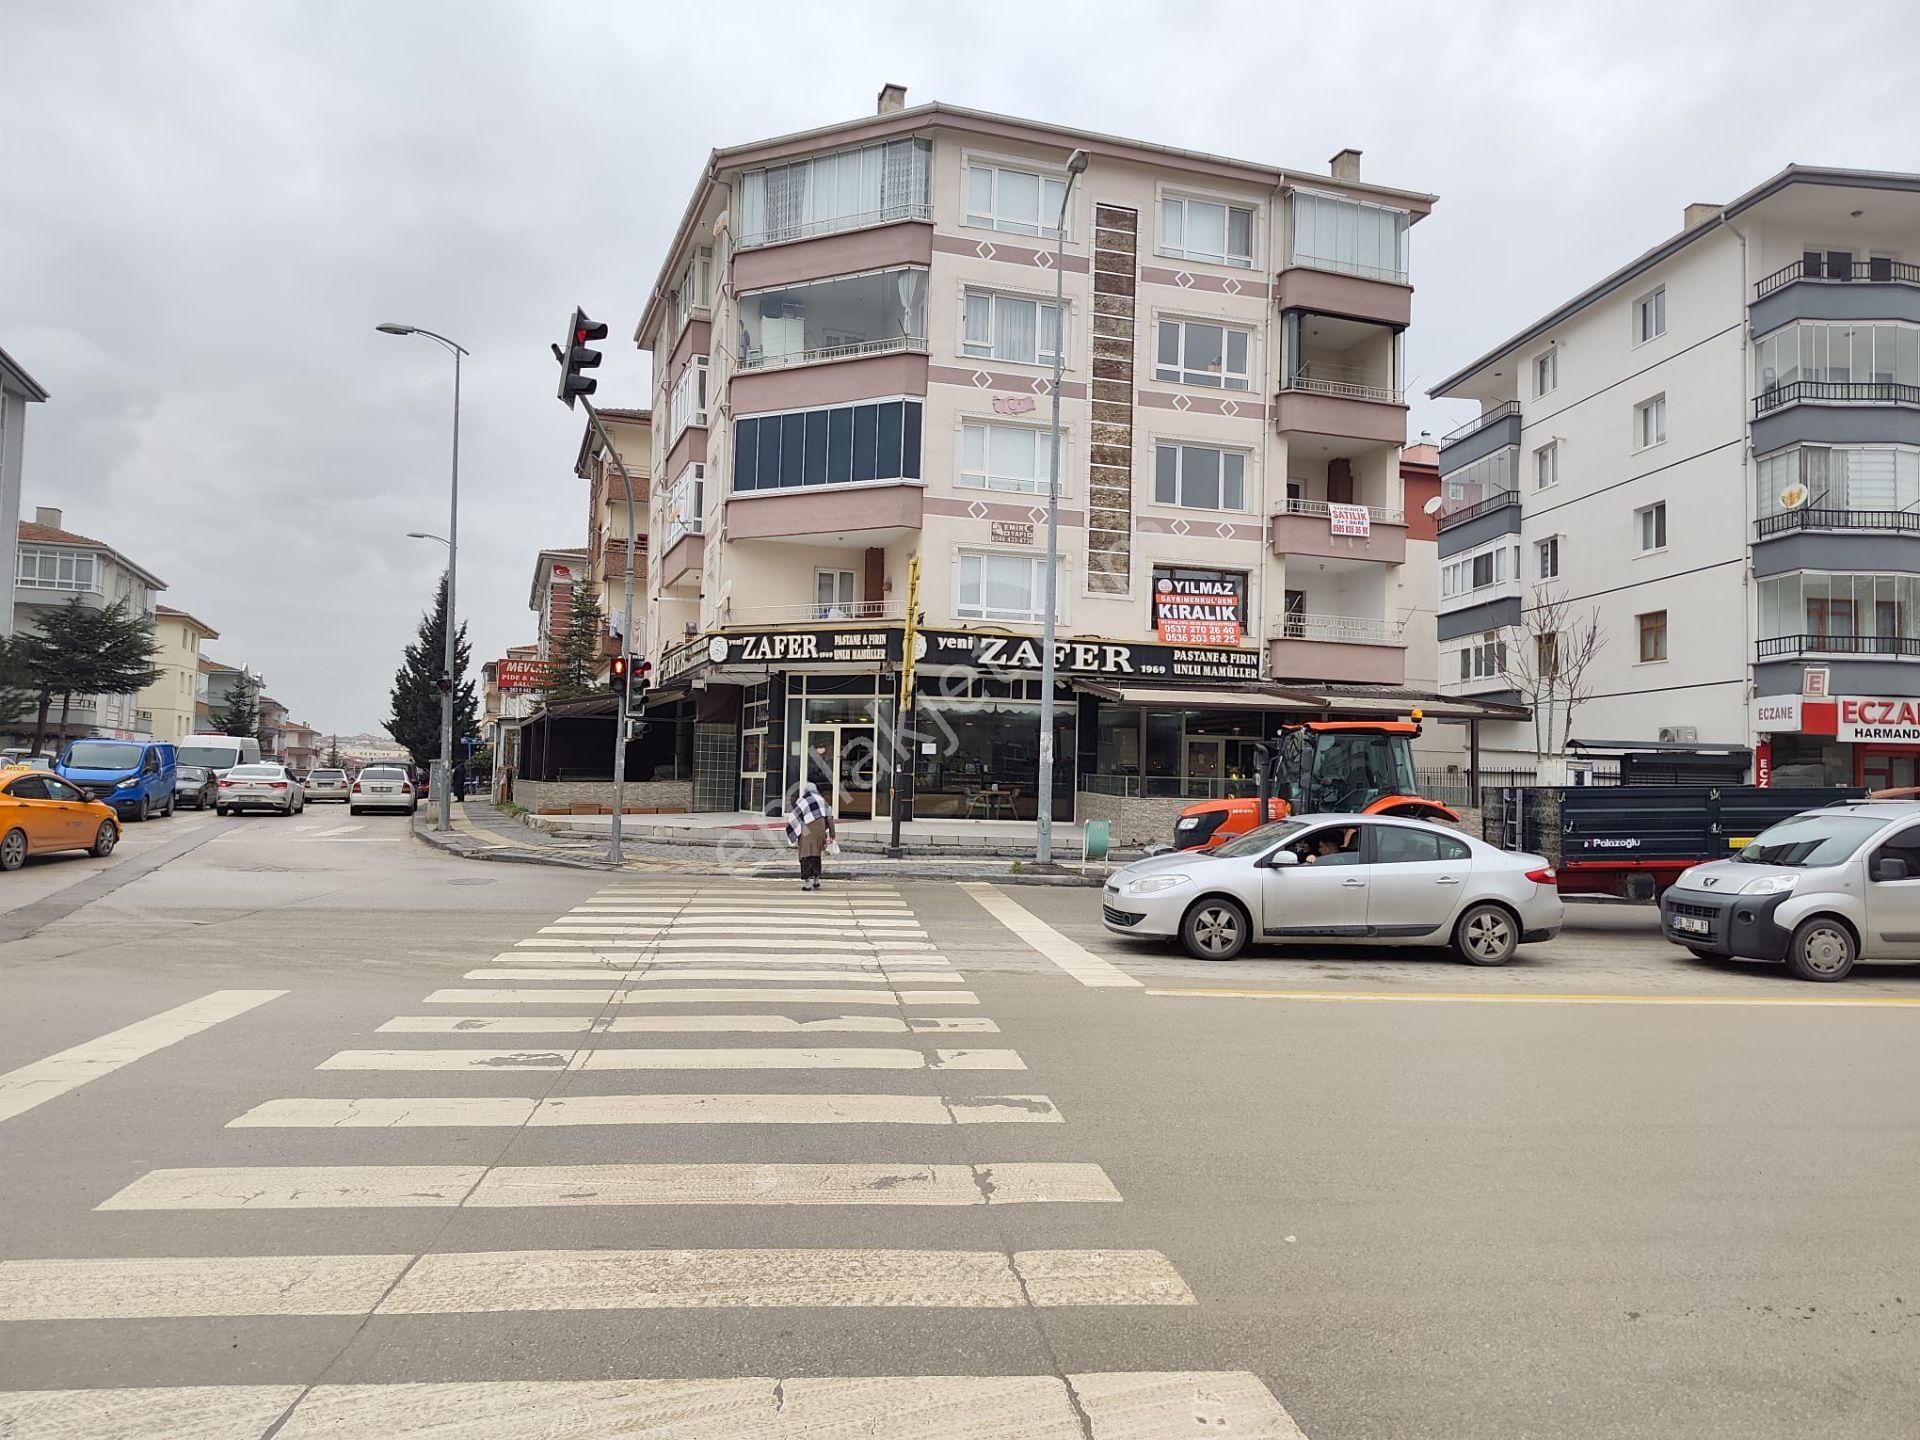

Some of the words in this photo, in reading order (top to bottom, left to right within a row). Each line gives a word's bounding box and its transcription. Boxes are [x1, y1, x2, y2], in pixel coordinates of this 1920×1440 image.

[1332, 511, 1367, 520] SATILIK
[1173, 581, 1234, 596] YILMAZ
[1164, 625, 1187, 633] 0537
[1190, 625, 1207, 634] 270
[1209, 626, 1220, 634] 26
[1223, 627, 1235, 635] 40
[834, 634, 861, 646] PASTANE
[862, 634, 868, 645] &
[1166, 634, 1187, 642] 0536
[1190, 634, 1207, 642] 203
[1210, 635, 1221, 643] 92
[741, 634, 819, 660] ZAFER
[937, 636, 973, 650] yeni
[977, 638, 1135, 673] ZAFER
[1140, 665, 1166, 674] 1969
[1173, 650, 1219, 662] PASTANE
[1220, 654, 1228, 663] &
[1230, 653, 1258, 665] FIRIN
[1173, 664, 1200, 675] UNLU
[1202, 665, 1258, 679] MAMÜLLER
[1808, 675, 1822, 692] E
[1758, 706, 1793, 721] ECZANE
[1842, 701, 1920, 725] ECZA
[1854, 728, 1920, 739] HARMAND
[1593, 838, 1641, 849] Palazoğlu
